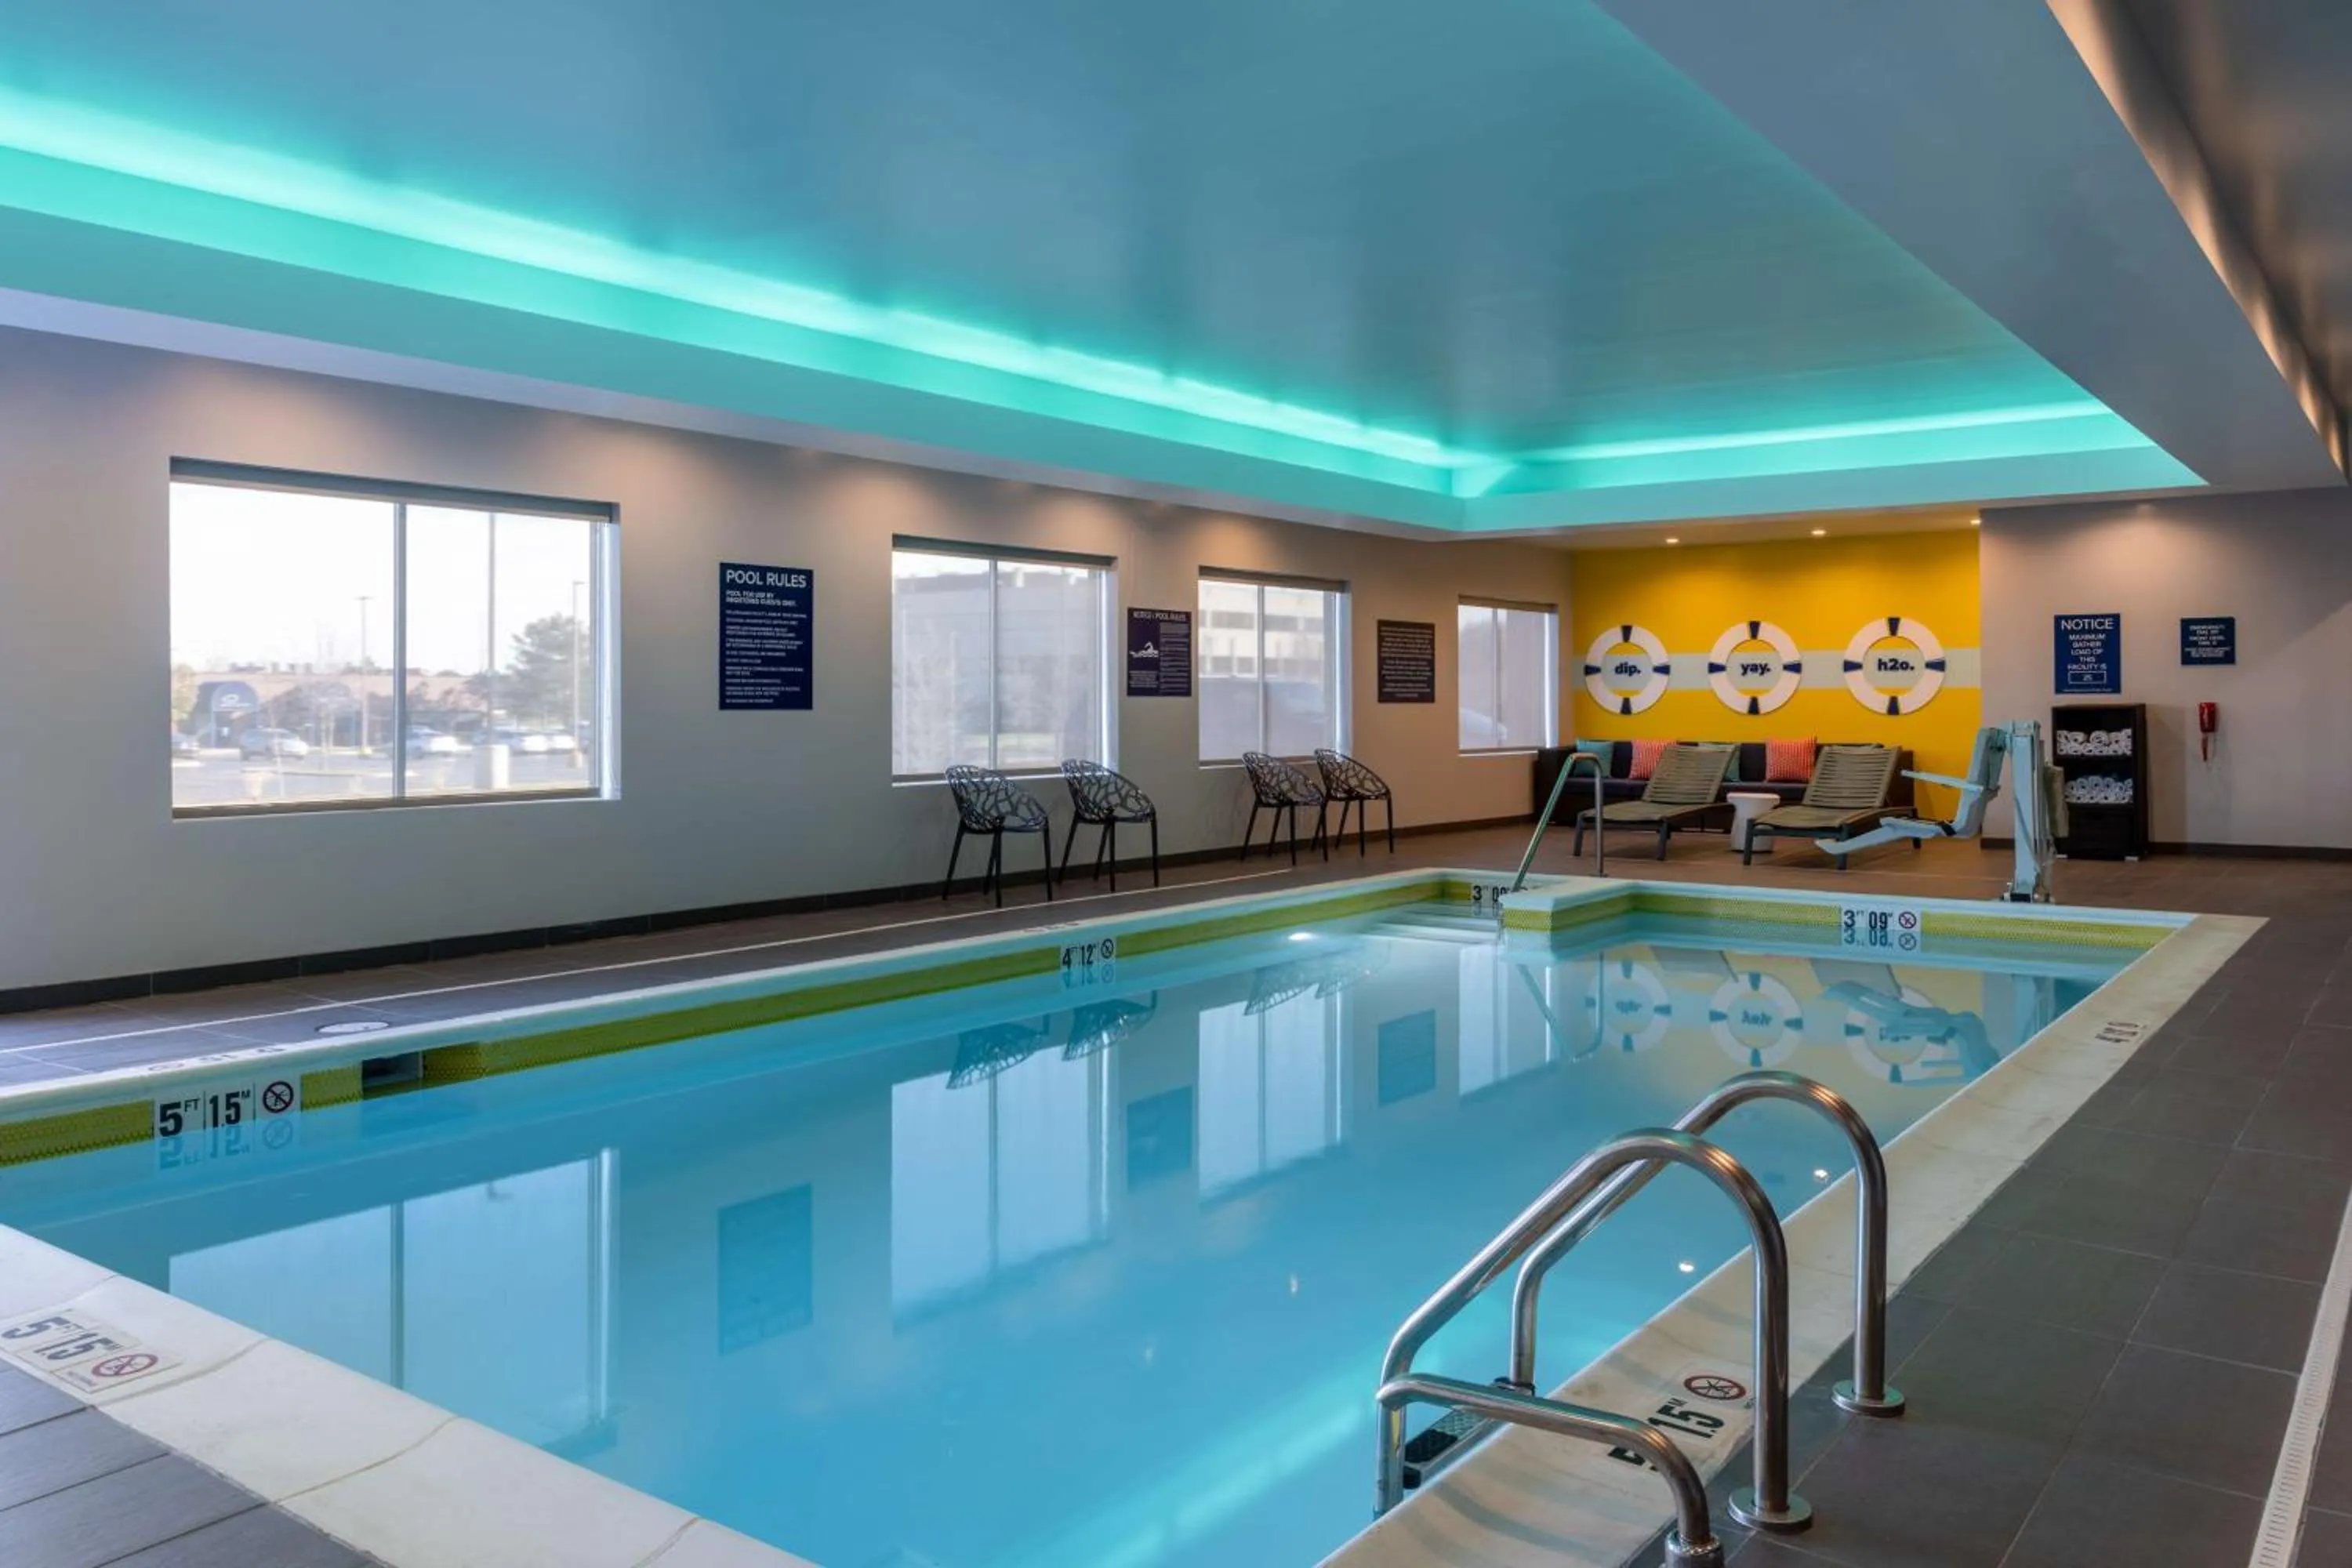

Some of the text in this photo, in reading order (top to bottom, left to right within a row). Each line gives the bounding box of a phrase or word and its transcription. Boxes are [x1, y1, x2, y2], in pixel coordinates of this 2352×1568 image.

[726, 569, 807, 588] POOL RULES
[2061, 617, 2114, 630] NOTICE
[1615, 662, 1642, 677] dip.
[1740, 663, 1771, 677] yay.
[1878, 658, 1915, 672] h2o.
